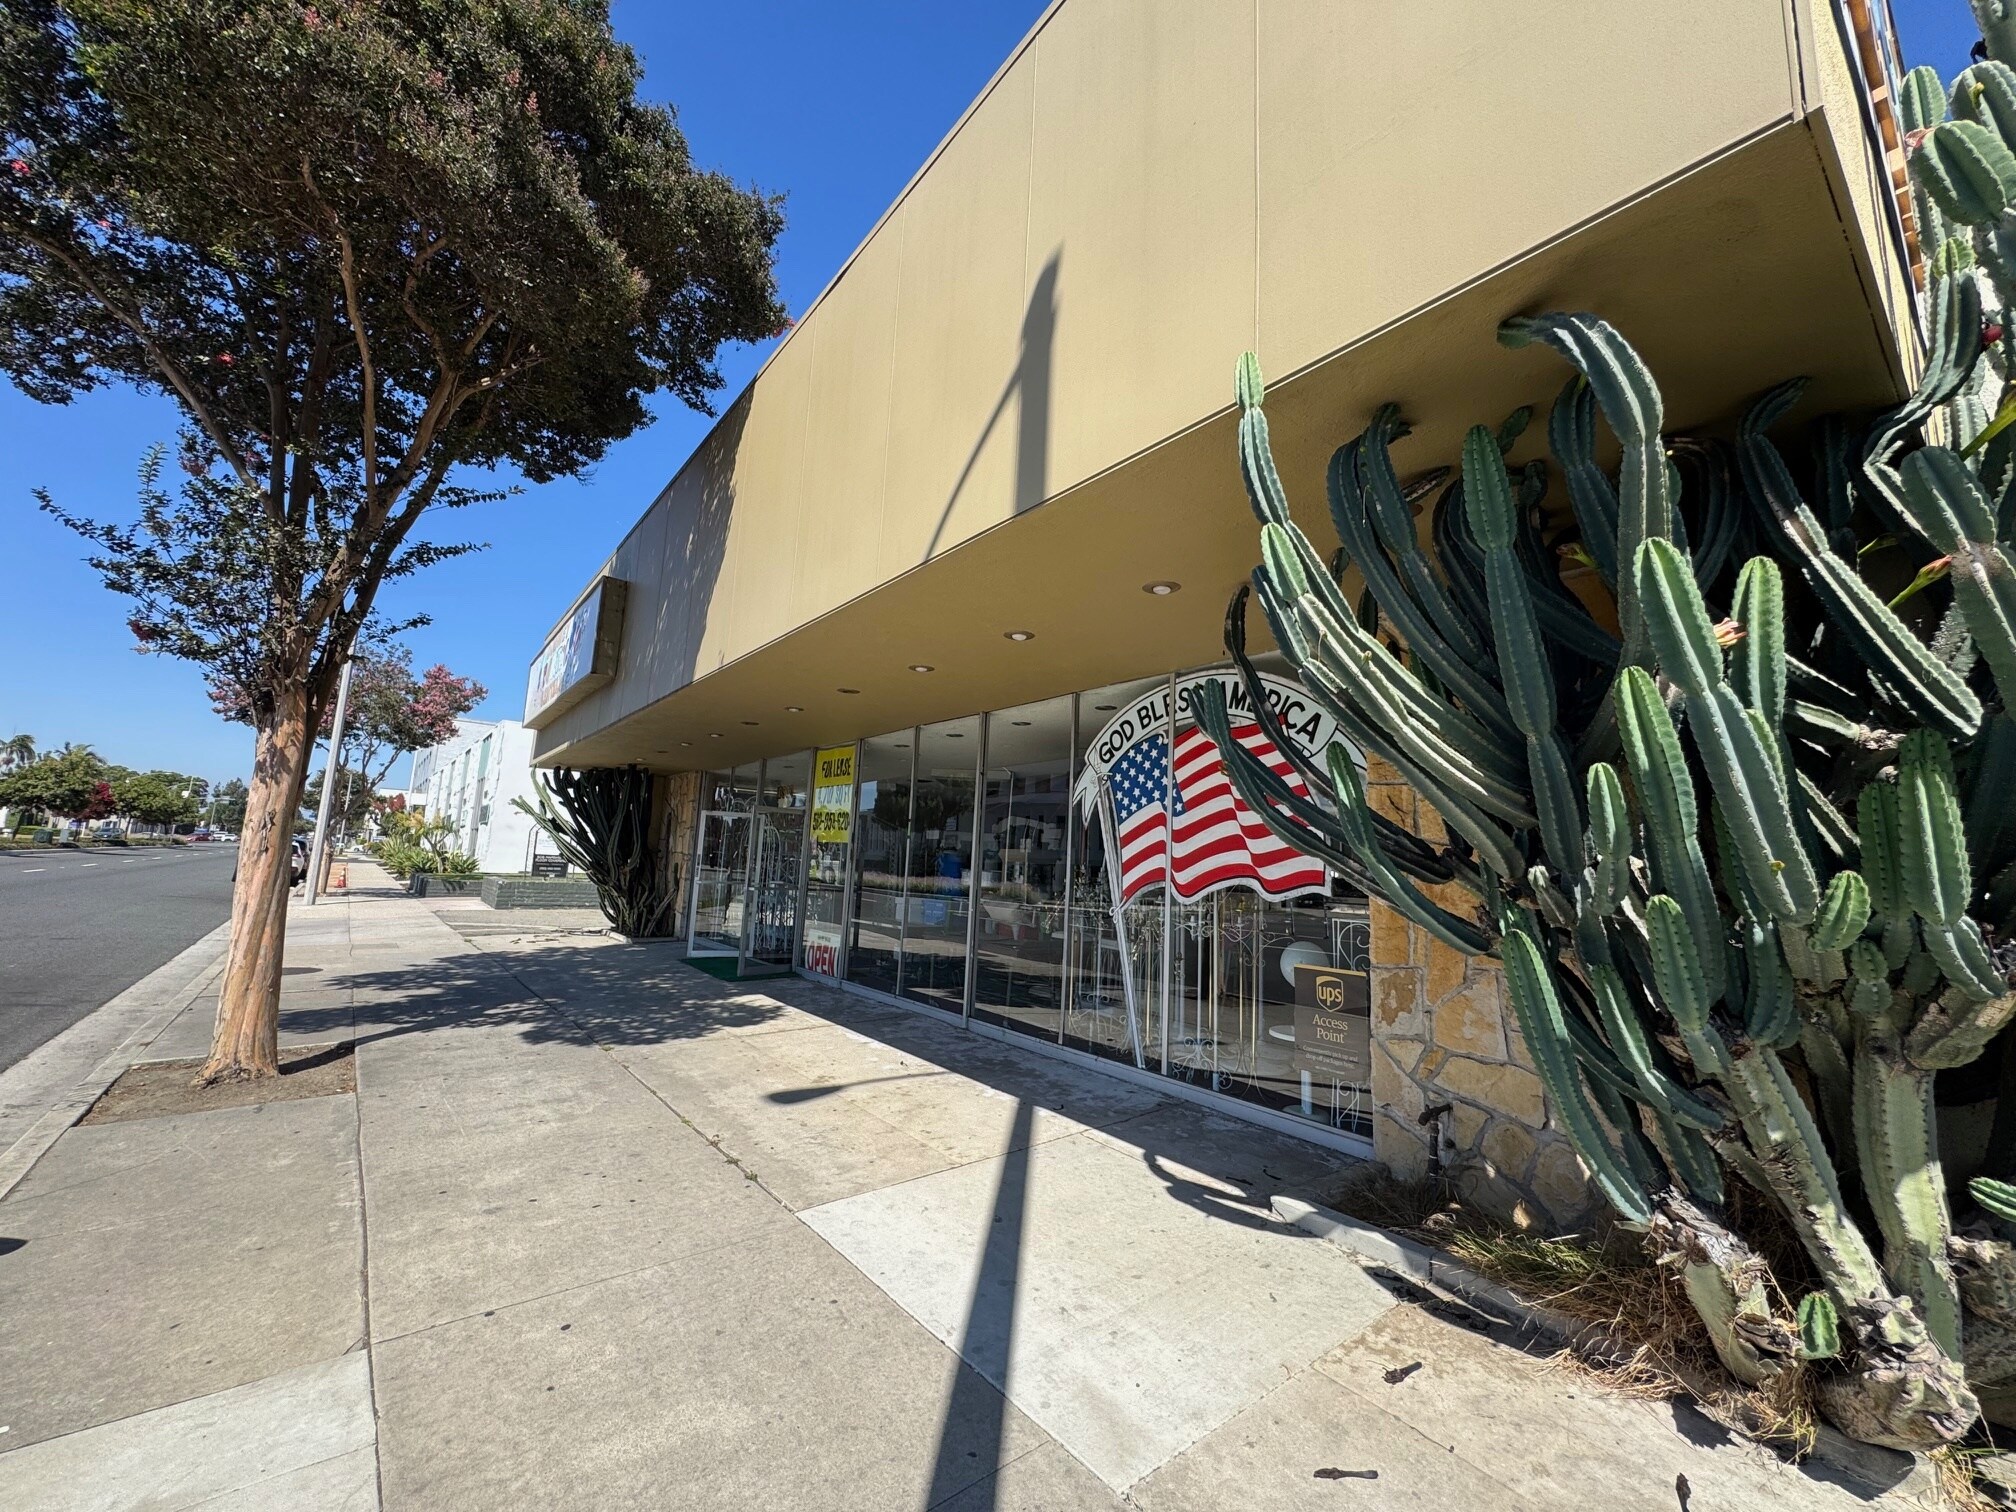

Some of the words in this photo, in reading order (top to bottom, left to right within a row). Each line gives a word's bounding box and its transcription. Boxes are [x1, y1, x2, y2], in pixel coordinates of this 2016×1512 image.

[1099, 719, 1135, 764] GOD
[1136, 684, 1204, 730] BLES
[821, 760, 833, 779] FOR
[833, 757, 852, 777] LEASE
[807, 943, 838, 977] OPEN
[1318, 986, 1342, 1006] ups
[1312, 1013, 1348, 1031] Access
